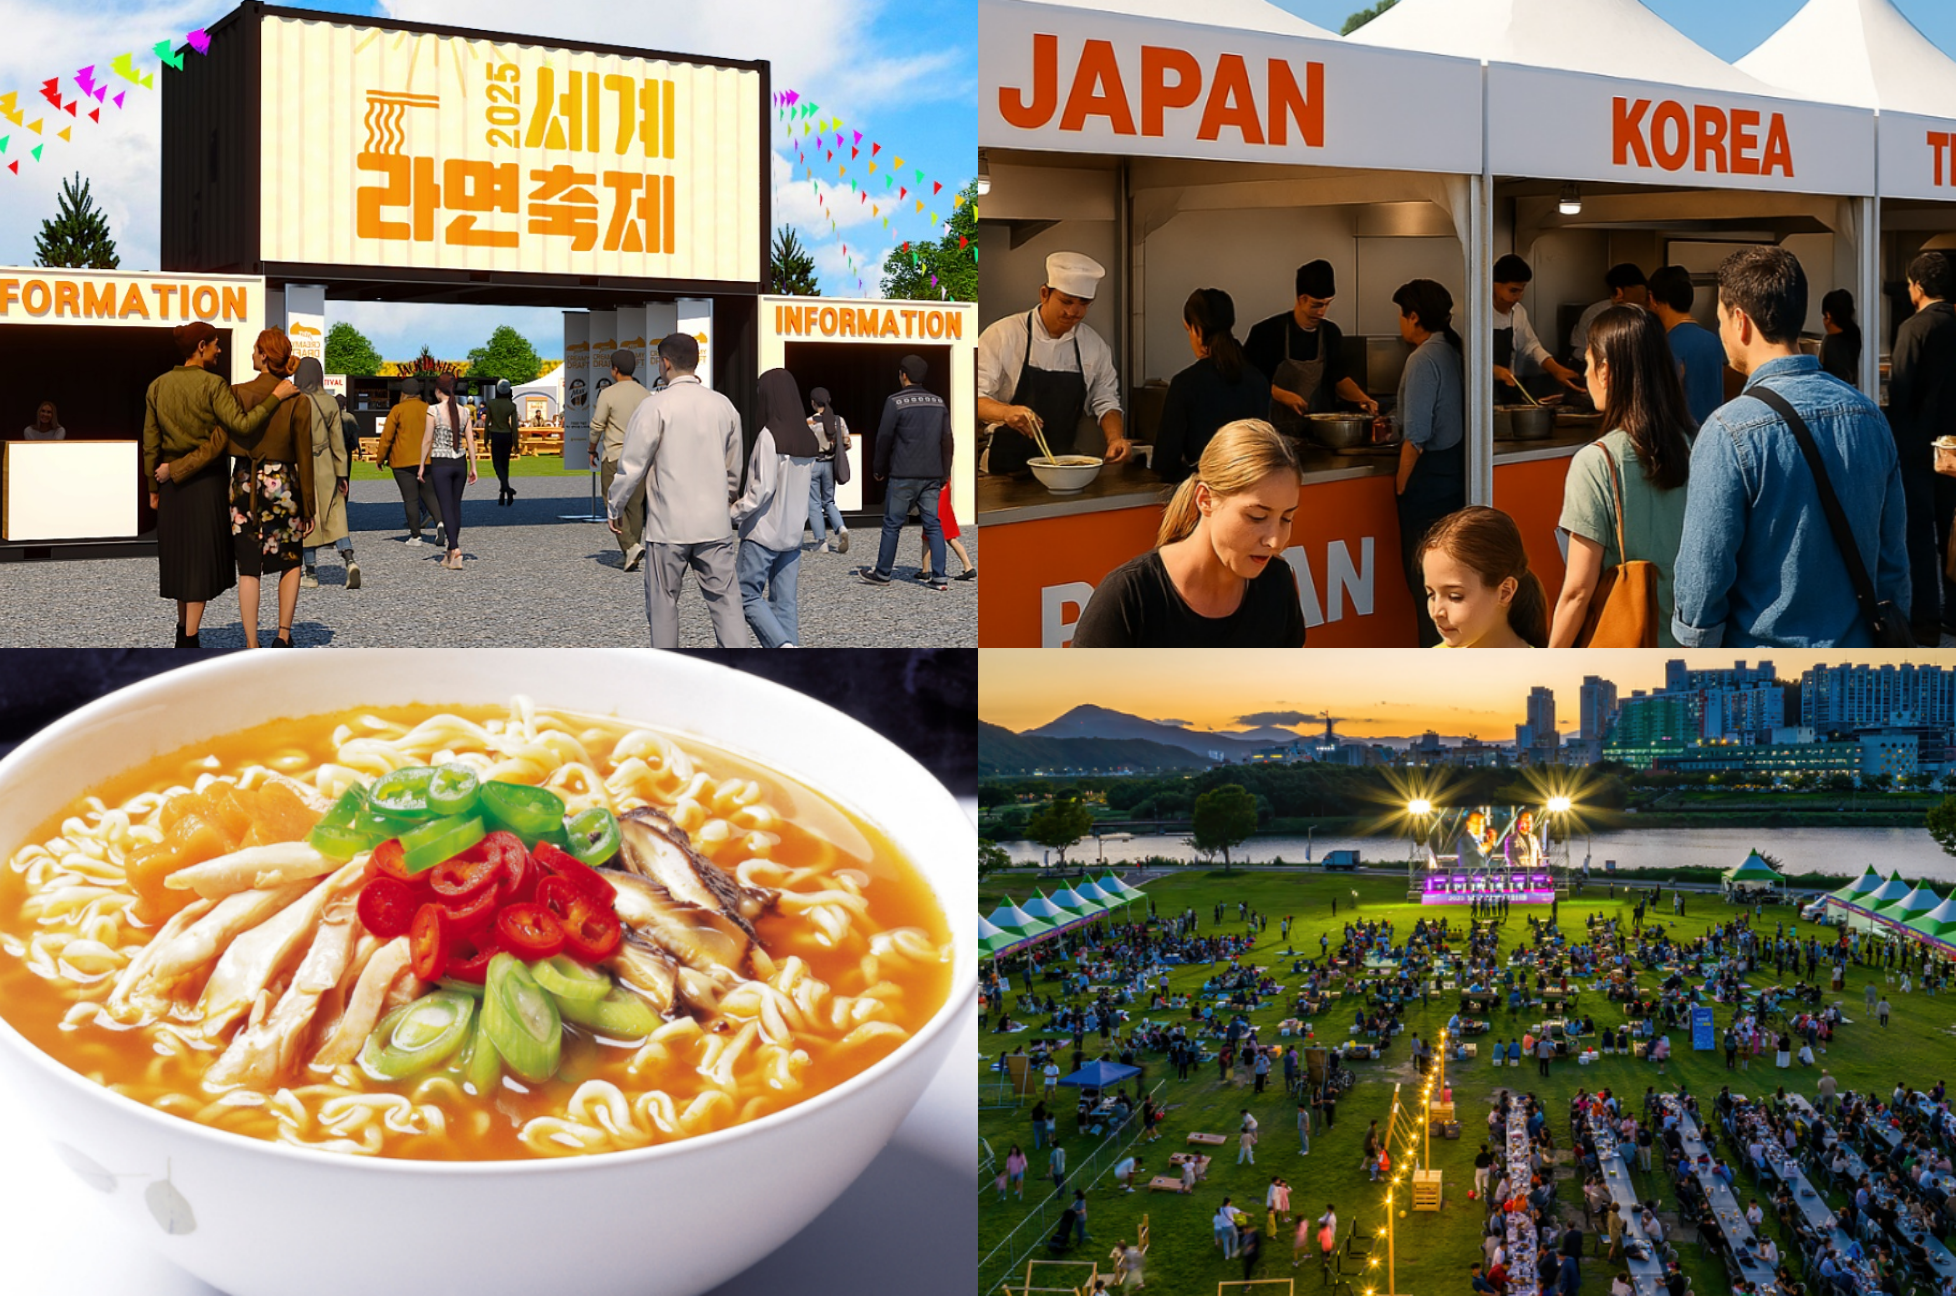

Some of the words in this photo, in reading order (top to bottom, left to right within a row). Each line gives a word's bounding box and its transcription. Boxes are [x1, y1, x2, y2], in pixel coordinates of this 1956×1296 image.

[485, 62, 520, 149] 2025
[525, 66, 675, 160] 세계
[998, 33, 1325, 148] JAPAN
[1612, 96, 1794, 178] KOREA
[356, 152, 675, 254] 라면축제
[775, 305, 962, 339] INFORMATION
